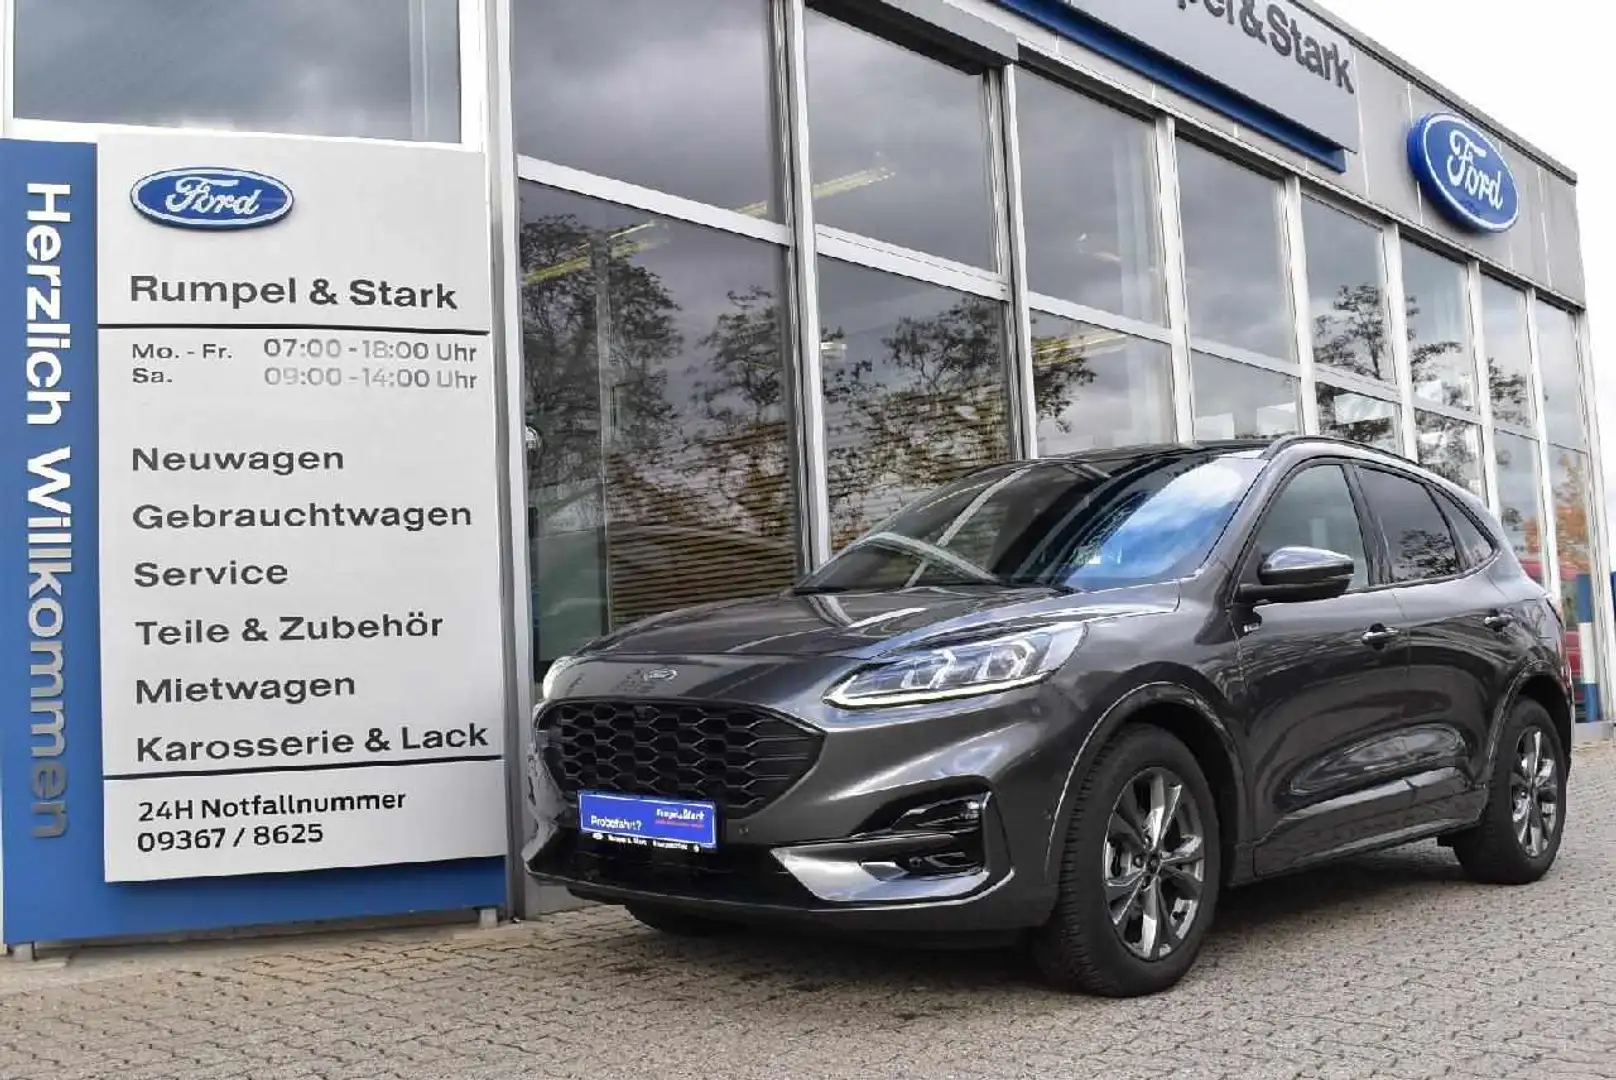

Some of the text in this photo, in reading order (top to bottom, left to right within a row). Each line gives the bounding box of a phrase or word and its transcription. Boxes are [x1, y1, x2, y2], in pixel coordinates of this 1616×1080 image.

[1447, 129, 1504, 210] Ford
[165, 176, 263, 215] Ford
[26, 182, 71, 425] Herzlich
[130, 275, 459, 310] Rumpel & Stark
[132, 343, 180, 359] Mo.
[202, 343, 233, 359] Fr.
[263, 338, 342, 358] 07:00
[436, 342, 477, 363] Uhr
[132, 367, 173, 384] Sa.
[263, 366, 342, 387] 09:00
[436, 369, 478, 390] Uhr
[132, 447, 344, 477] Neuwagen
[132, 502, 472, 532] Gebrauchtwagen
[133, 559, 289, 588] Service
[26, 446, 72, 839] Willkommen
[135, 610, 444, 646] Teile & Zubehör
[136, 676, 356, 705] Mietwagen
[137, 722, 489, 763] Karosserie & Lack
[138, 791, 407, 822] 24H Notfallnummer
[137, 823, 324, 853] 09367 / 8625
